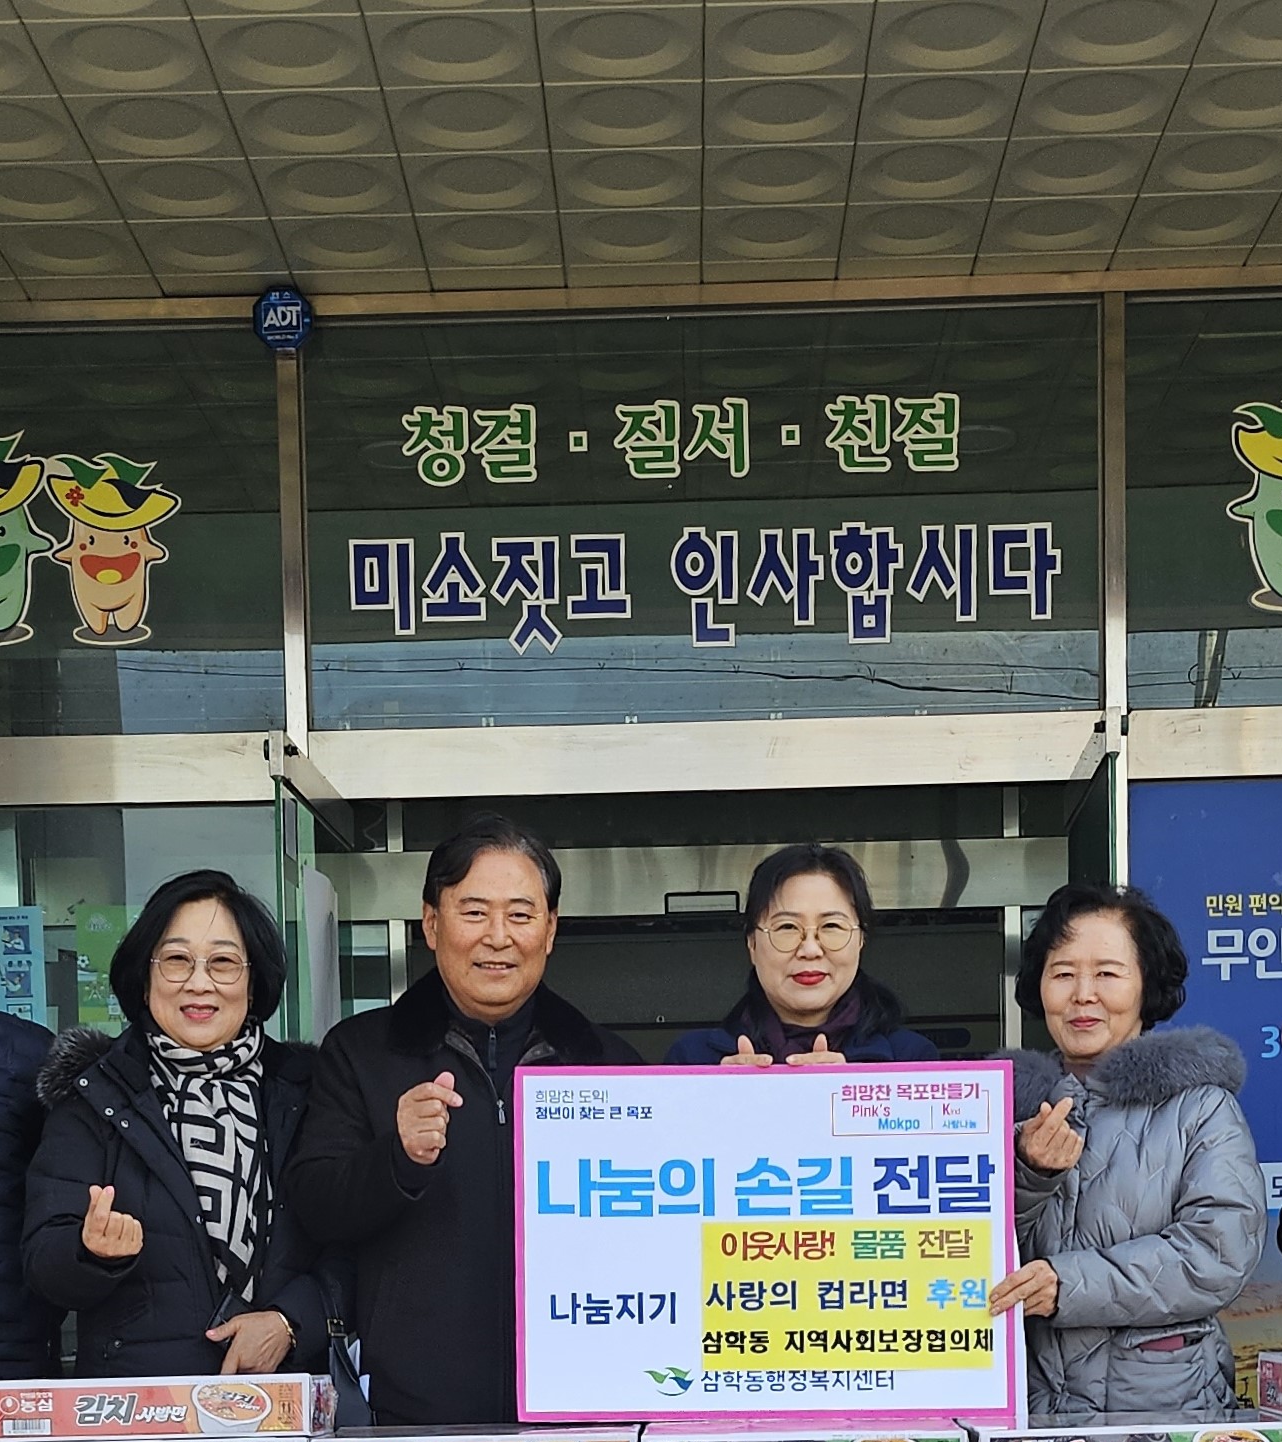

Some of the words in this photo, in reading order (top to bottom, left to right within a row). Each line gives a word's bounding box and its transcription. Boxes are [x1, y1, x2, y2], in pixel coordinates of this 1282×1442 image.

[263, 306, 301, 328] ADT
[402, 403, 537, 487] 청결
[615, 398, 751, 479] 질서
[825, 392, 961, 473] 친절
[348, 531, 632, 655] 미소짓고
[670, 521, 1062, 649] 인사합시다
[1206, 893, 1243, 917] 민원
[535, 1090, 574, 1104] 희망찬
[841, 1084, 892, 1102] 희망찬
[896, 1083, 980, 1101] 목포만들기
[535, 1106, 575, 1120] 청년이
[579, 1106, 605, 1120] 찾는
[610, 1106, 622, 1120] 큰
[627, 1106, 653, 1120] 목포
[878, 1118, 920, 1132] Mokpo
[536, 1157, 716, 1218] 나눔의
[734, 1156, 854, 1216] 손길
[873, 1154, 995, 1215] 전달
[721, 1229, 836, 1262] 이웃사랑!
[850, 1229, 907, 1260] 물품
[917, 1228, 973, 1260] 전달
[705, 1280, 798, 1311] 사랑의
[817, 1279, 908, 1310] 컵라면
[926, 1278, 989, 1309] 후원
[549, 1292, 678, 1326] 나눔지기
[701, 1330, 770, 1355] 삼학동
[784, 1328, 994, 1354] 지역사회보장협의체
[701, 1370, 896, 1393] 삼학동행정복지센터
[20, 1399, 54, 1413] 농심
[73, 1393, 138, 1426] 김치
[134, 1405, 189, 1423] 사발면
